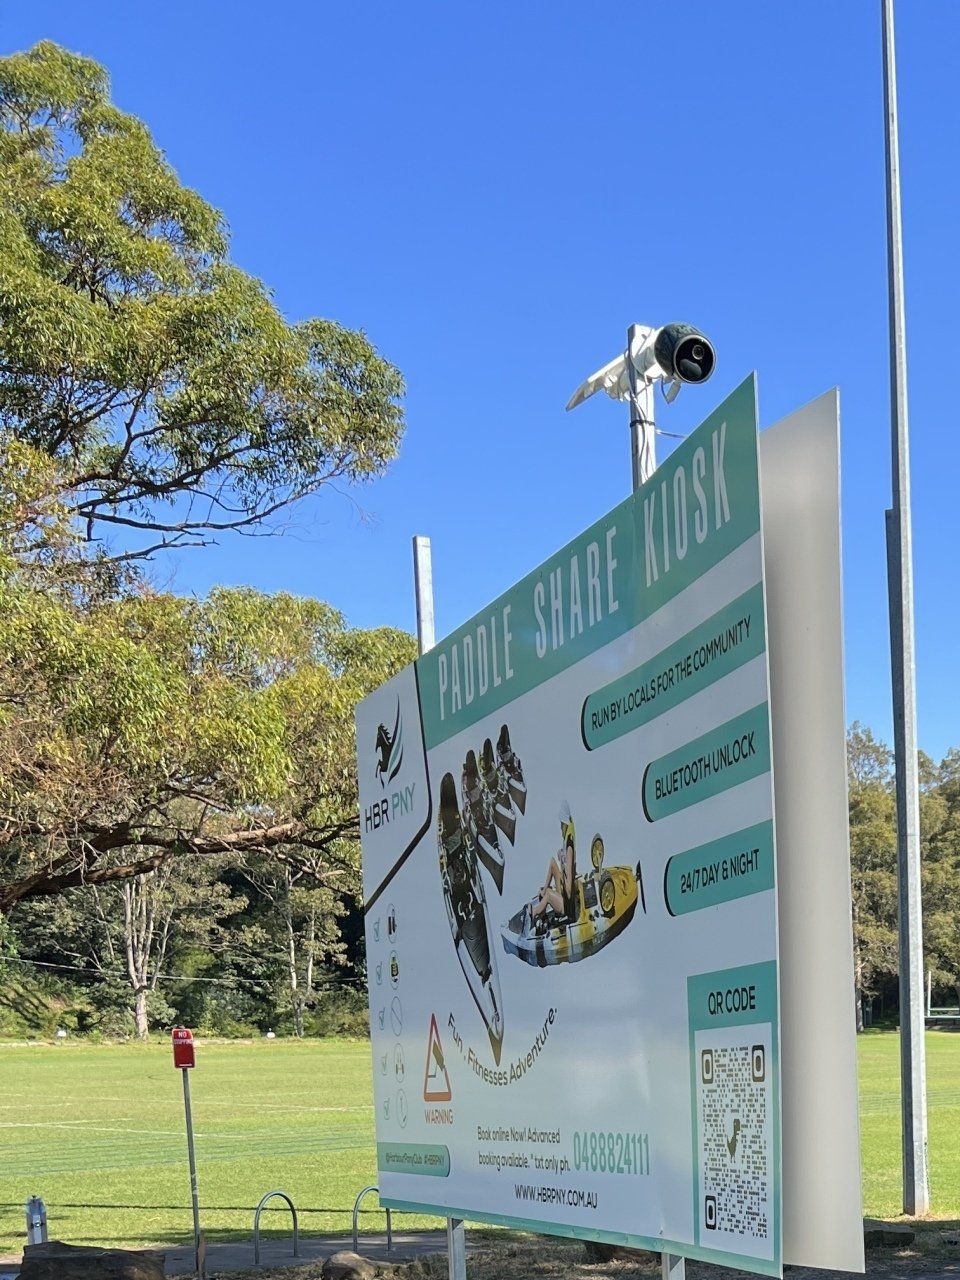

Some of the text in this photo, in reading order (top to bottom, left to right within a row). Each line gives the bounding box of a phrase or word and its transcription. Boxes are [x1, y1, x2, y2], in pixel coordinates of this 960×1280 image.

[438, 422, 731, 720] PADDLE SHARE KIOSK
[591, 615, 751, 731] RUN BY LOCALS FOR THE COMMUNITY
[655, 731, 756, 800] BLUETOOTH UNLOCK
[364, 782, 416, 833] HBR PNY
[681, 848, 760, 894] 24/7 DAY & NIGHT
[708, 985, 756, 1015] QR CODE
[448, 1012, 463, 1053] Fun
[467, 1047, 508, 1086] Fitnesses
[424, 1108, 454, 1125] WARNING
[477, 1125, 491, 1141] Book
[492, 1126, 510, 1142] online
[527, 1127, 561, 1144] Advanced
[478, 1150, 501, 1172] booking
[534, 1155, 544, 1170] txt
[544, 1155, 559, 1175] only
[559, 1155, 571, 1175] ph.
[573, 1131, 651, 1176] 0488824111
[514, 1183, 598, 1209] WWW.HBRPNY.COM.AU
